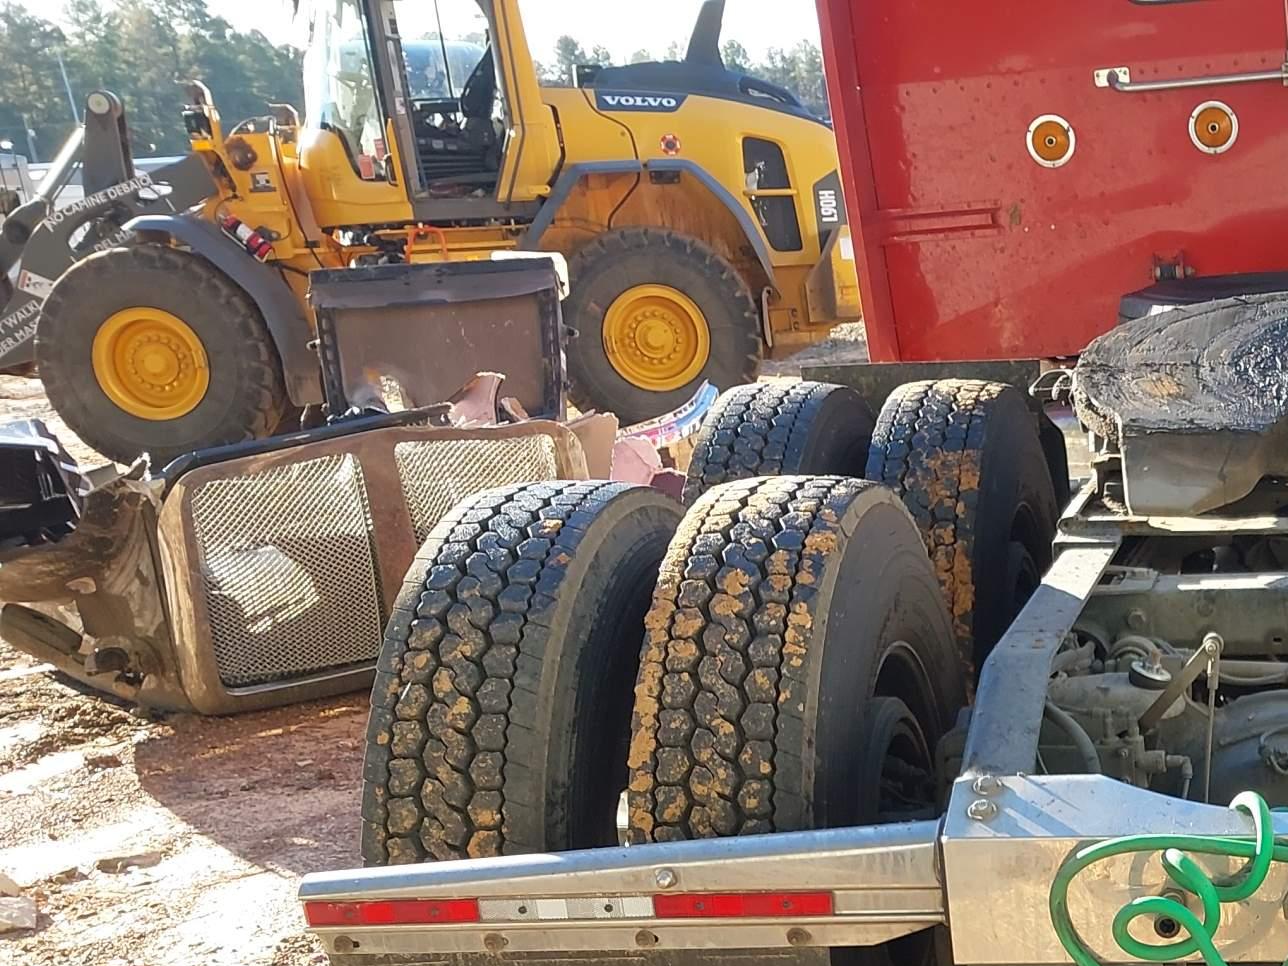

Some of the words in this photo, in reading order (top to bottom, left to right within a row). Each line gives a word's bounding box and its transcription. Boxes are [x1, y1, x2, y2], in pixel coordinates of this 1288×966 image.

[601, 95, 677, 107] VOLVO
[62, 192, 109, 216] CAMINE
[818, 190, 839, 222] L90H
